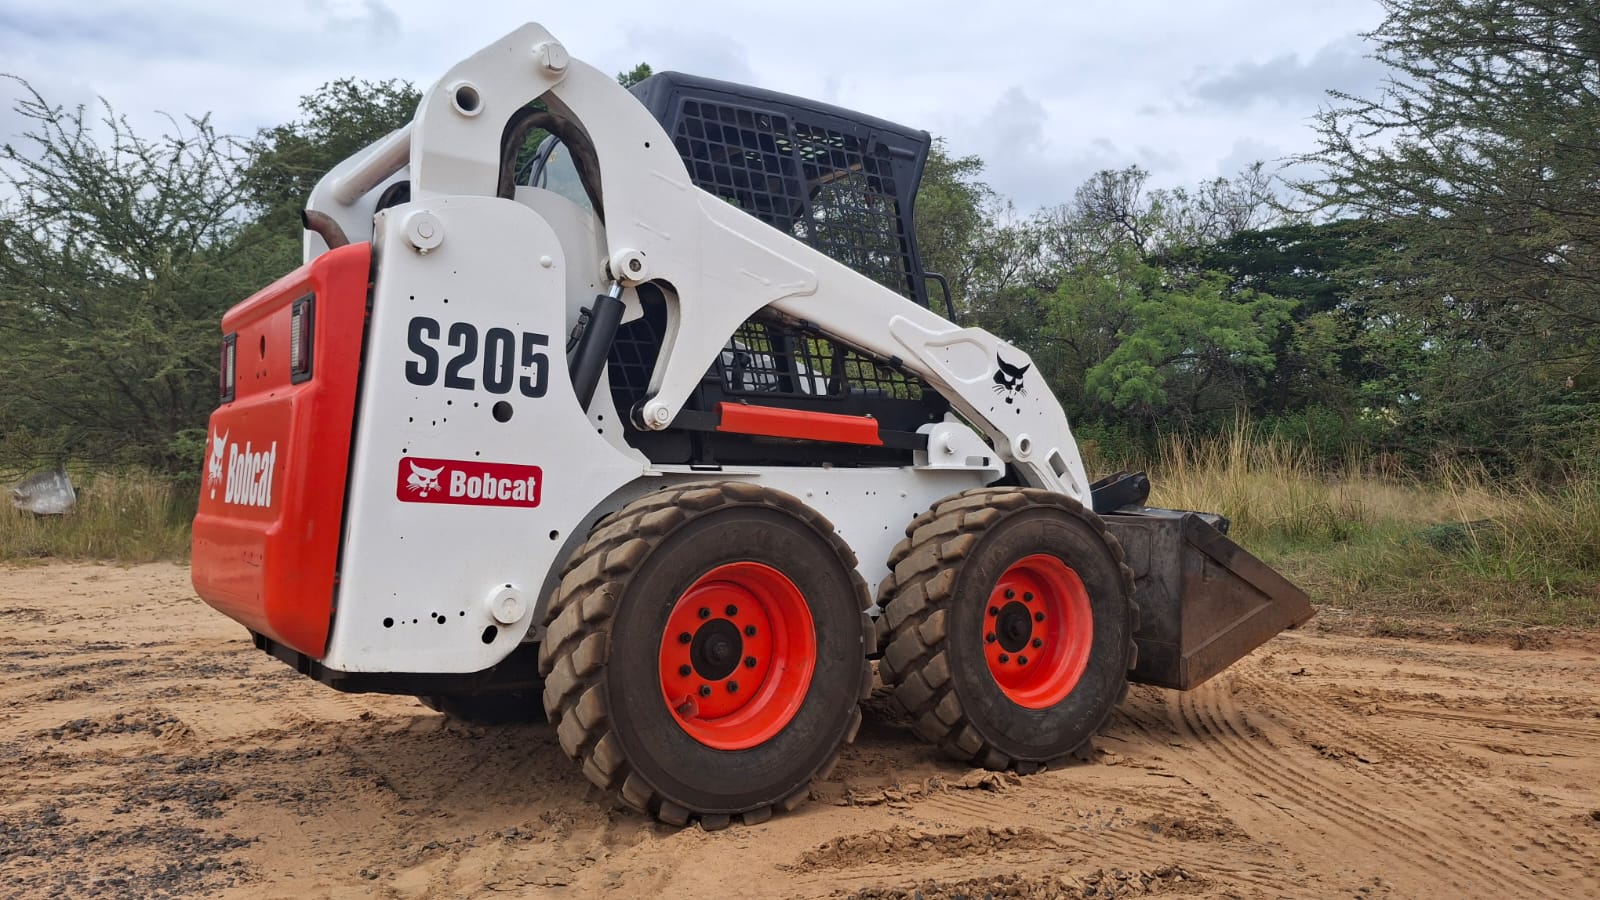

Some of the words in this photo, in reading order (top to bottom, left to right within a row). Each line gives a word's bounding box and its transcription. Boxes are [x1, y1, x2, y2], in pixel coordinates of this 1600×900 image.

[405, 316, 550, 398] S205
[225, 440, 277, 508] Bobcat
[449, 470, 536, 502] Bobcat
